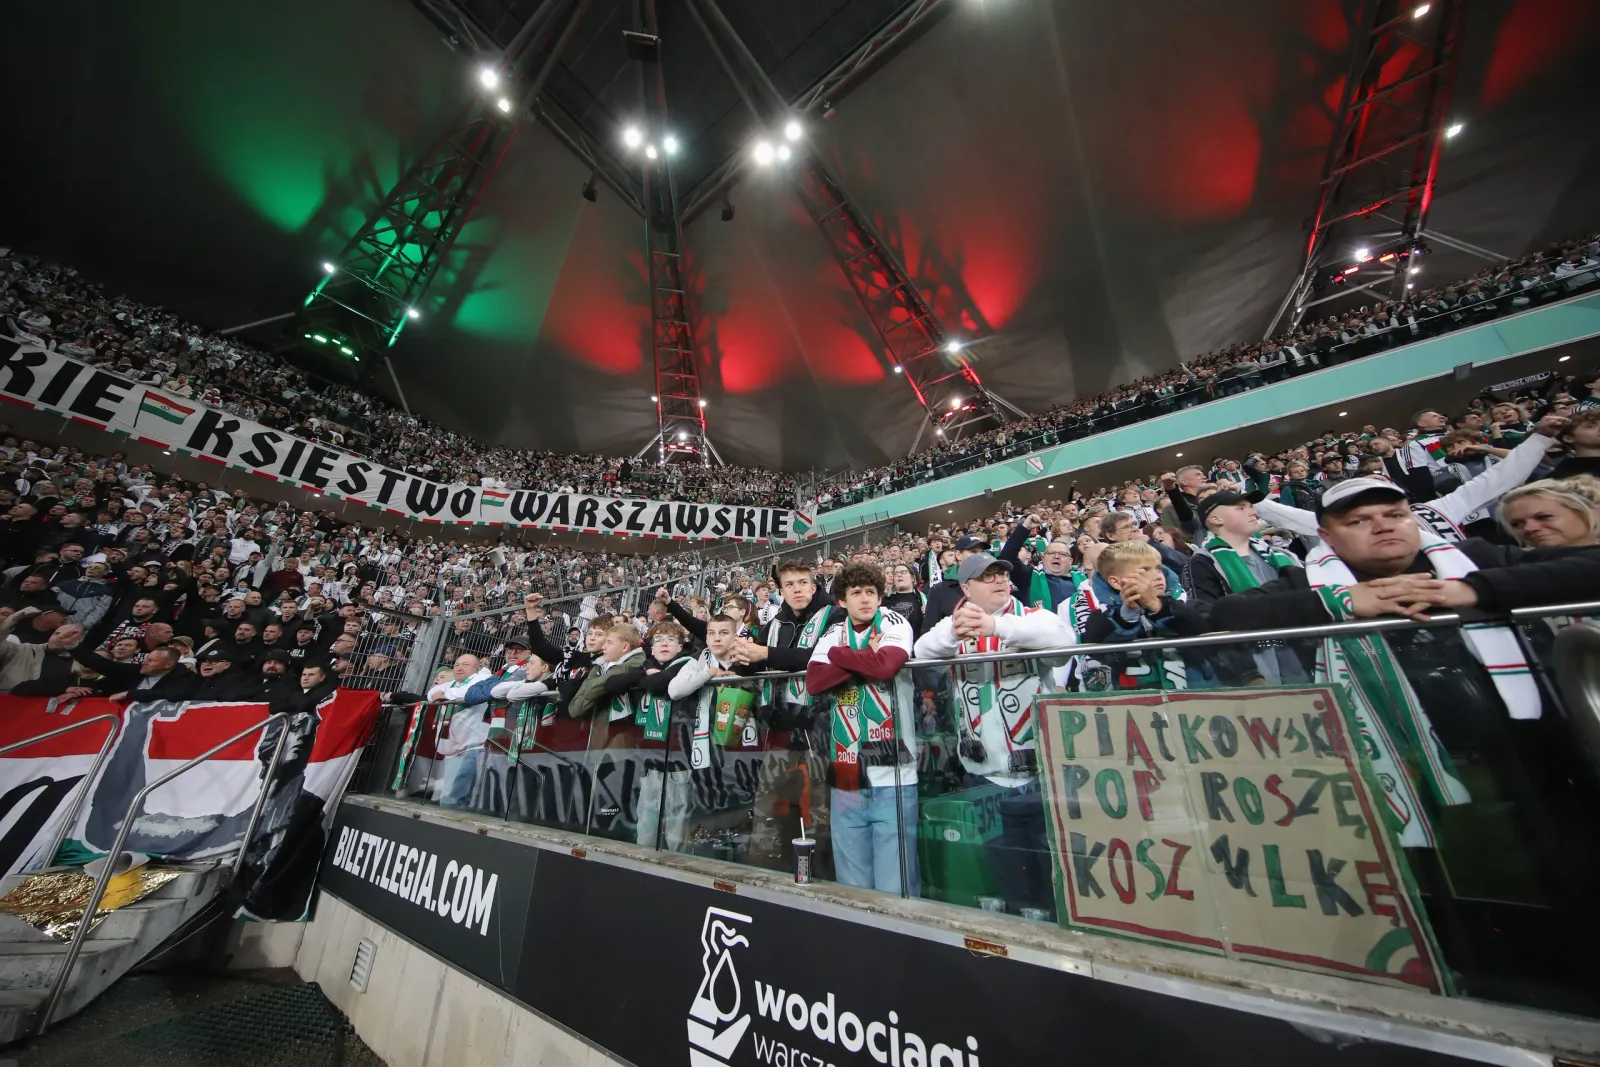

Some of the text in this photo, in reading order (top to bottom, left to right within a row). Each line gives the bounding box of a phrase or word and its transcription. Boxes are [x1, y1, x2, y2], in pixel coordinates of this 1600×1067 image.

[508, 490, 790, 538] WARSZAWSKIE
[869, 728, 891, 740] 2016
[837, 751, 857, 763] 2016
[332, 825, 499, 936] BILETY.LEGIA.COM
